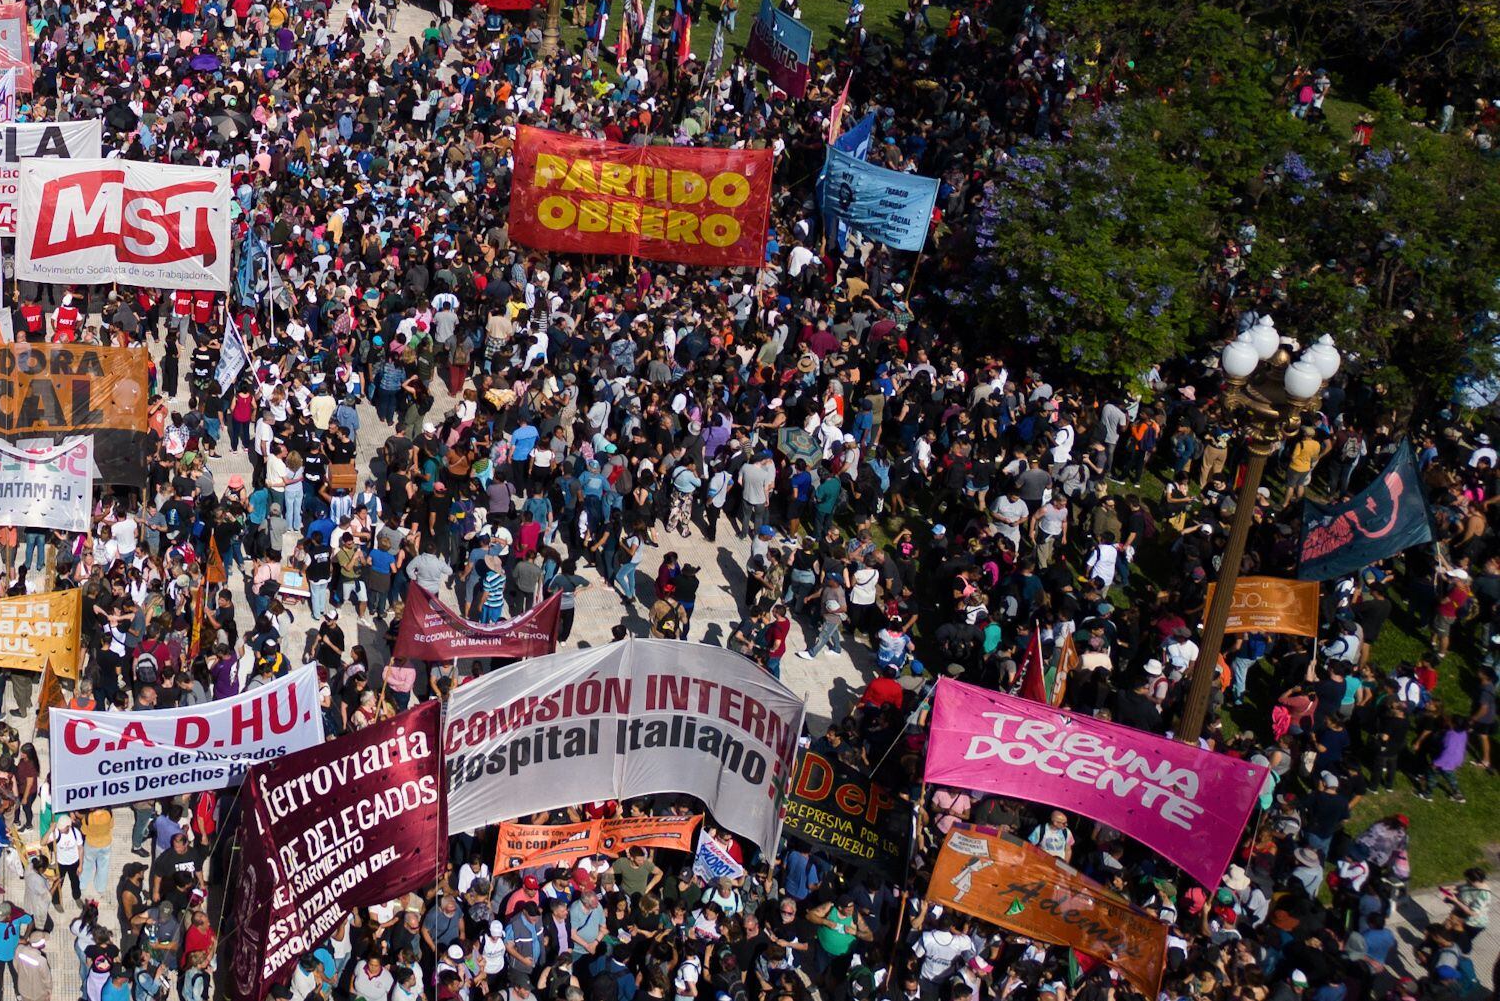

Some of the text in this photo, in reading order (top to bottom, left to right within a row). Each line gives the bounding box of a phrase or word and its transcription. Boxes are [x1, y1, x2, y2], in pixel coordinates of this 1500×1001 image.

[534, 153, 750, 208] PARTIDO
[47, 181, 214, 257] MST
[537, 195, 741, 247] OBRERO
[33, 263, 84, 275] Movimiento
[129, 266, 139, 275] de
[141, 267, 155, 278] los
[158, 269, 214, 281] Trabajadores
[97, 756, 163, 776] Centro
[167, 750, 191, 766] de
[258, 726, 431, 826] ferroviaria
[445, 714, 767, 793] Hospital Italiano
[963, 736, 1205, 831] DOCENTE
[65, 783, 98, 804] por
[102, 778, 130, 796] los
[135, 766, 224, 789] Derechos
[303, 774, 438, 862] DELEGADOS
[803, 821, 826, 842] DEL
[830, 831, 875, 860] PUEBLO
[860, 826, 879, 846] POR
[295, 834, 365, 895] SARMIENTO
[266, 845, 401, 951] ESTATIZACION DEL
[263, 902, 347, 980] ERROCARRIL
